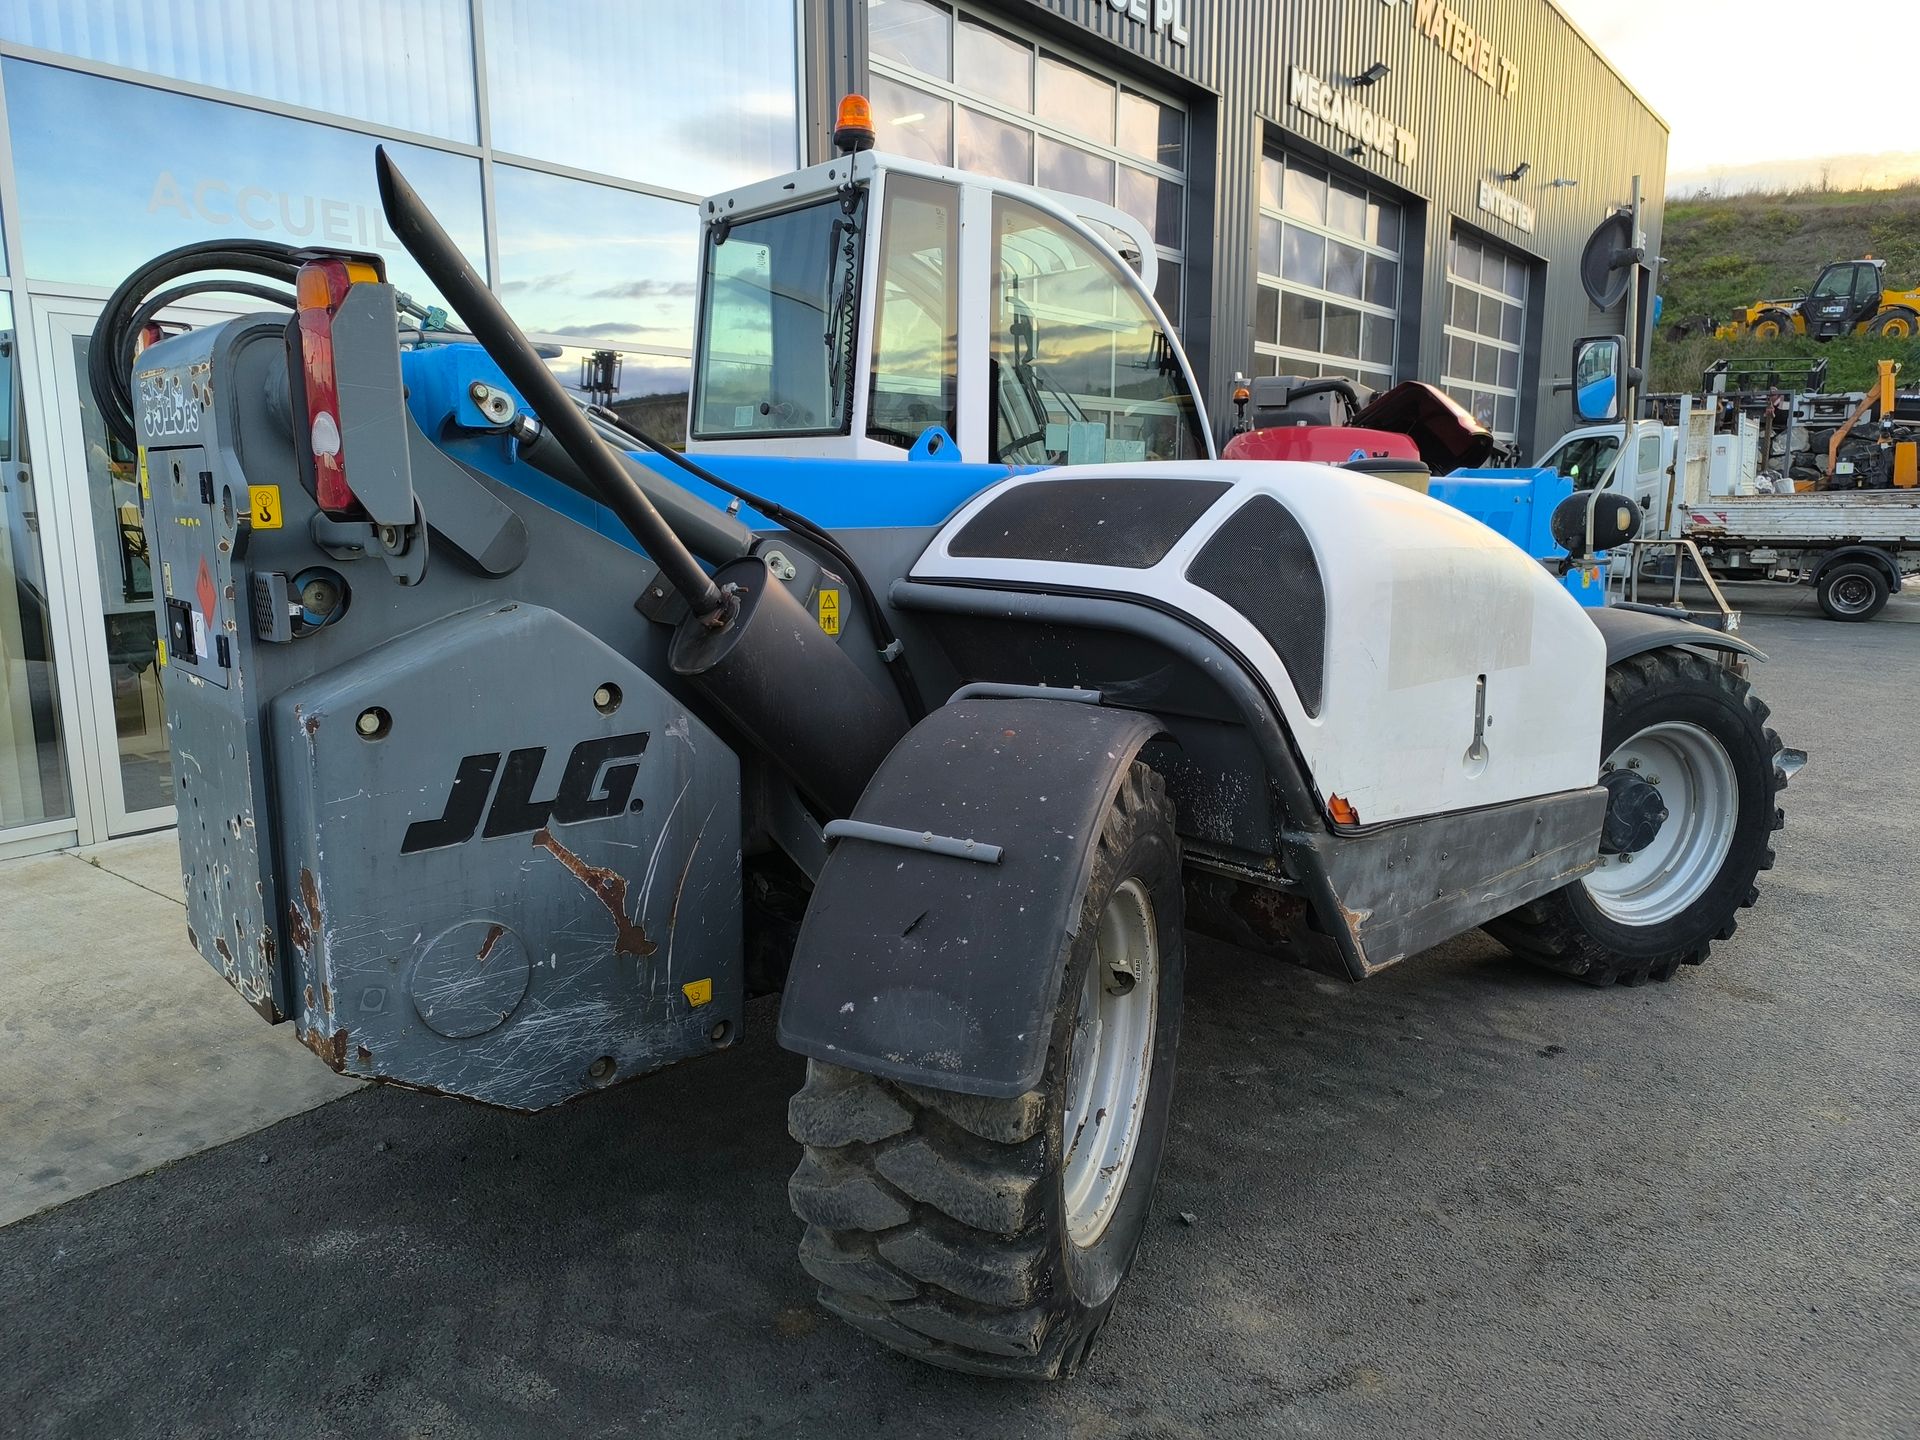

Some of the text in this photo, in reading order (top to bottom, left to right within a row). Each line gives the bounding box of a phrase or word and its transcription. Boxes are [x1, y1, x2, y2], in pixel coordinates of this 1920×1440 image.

[1290, 65, 1395, 156] MECANIQUE
[146, 170, 402, 252] ACCUEIL
[1822, 305, 1845, 313] JCB
